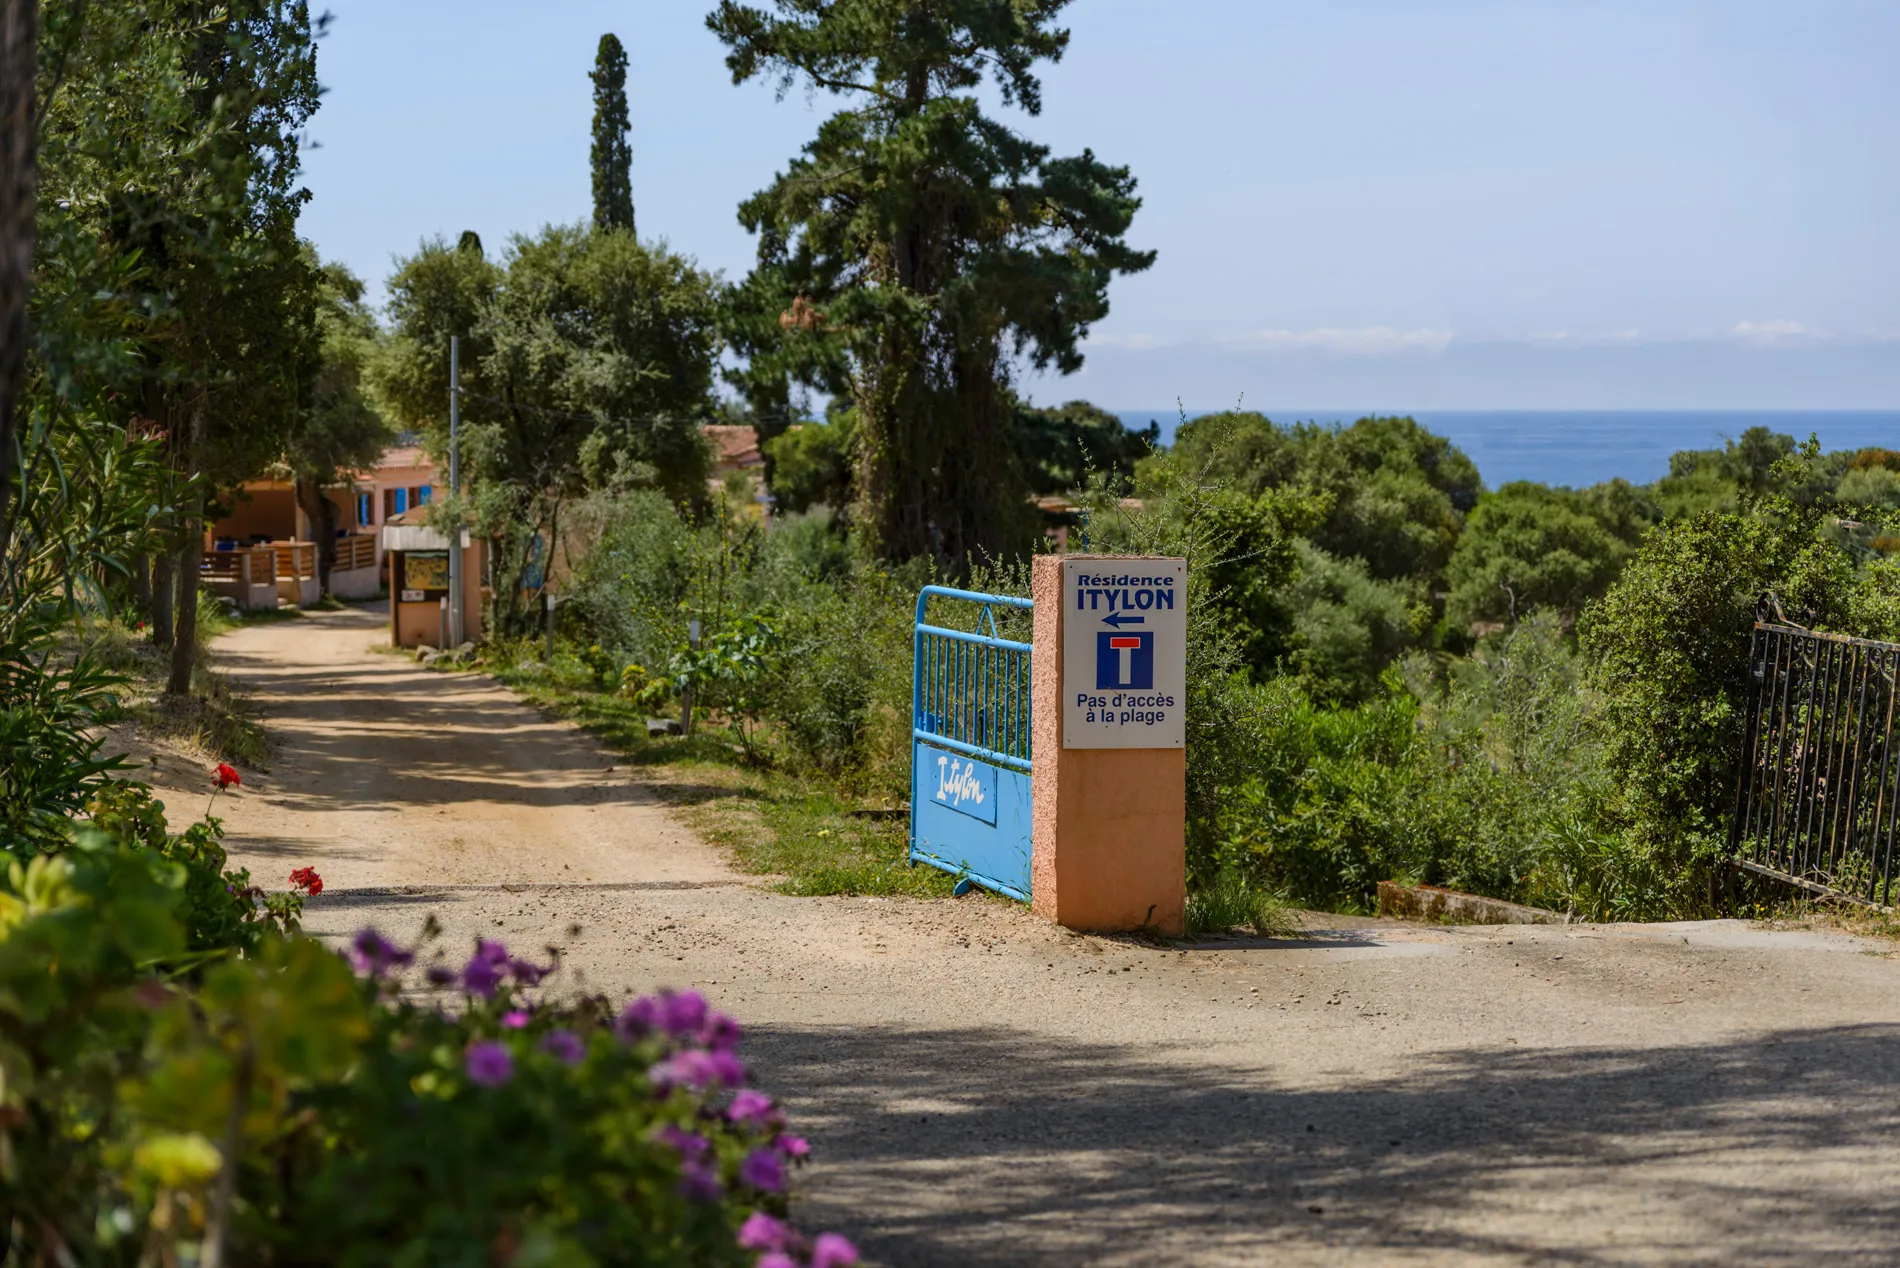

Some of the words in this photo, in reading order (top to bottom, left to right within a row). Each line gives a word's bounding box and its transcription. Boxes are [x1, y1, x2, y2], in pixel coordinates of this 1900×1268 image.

[1077, 573, 1174, 586] Résidence
[1077, 589, 1174, 612] ITYLON
[1077, 693, 1107, 708] Pas
[1112, 692, 1175, 708] d'accès
[1086, 708, 1095, 723] à
[1101, 709, 1114, 723] la
[1120, 709, 1165, 725] plage
[936, 756, 985, 806] Itylon
